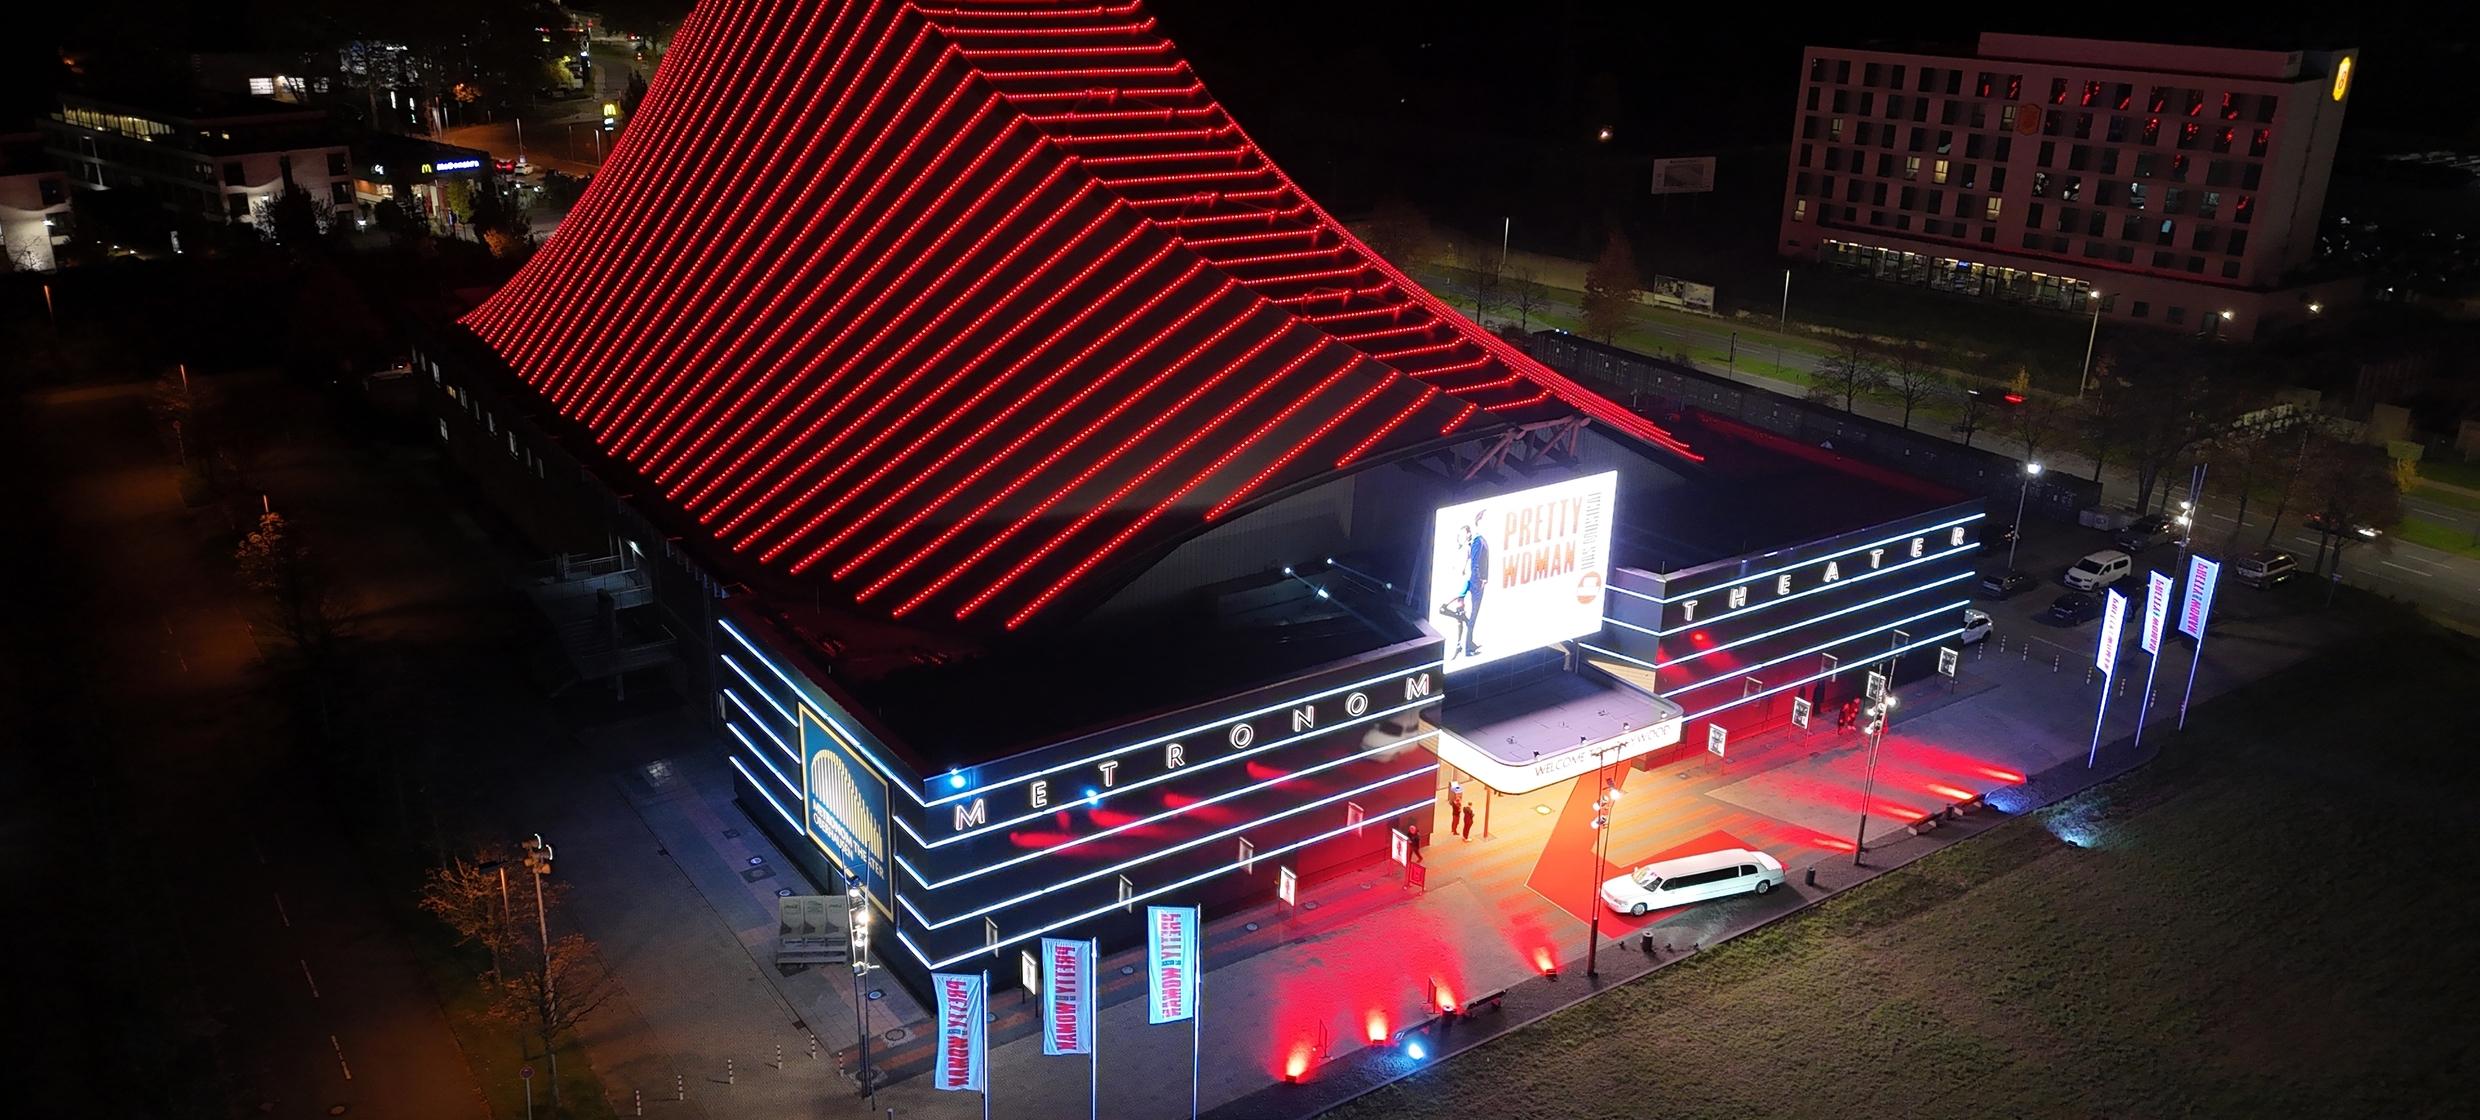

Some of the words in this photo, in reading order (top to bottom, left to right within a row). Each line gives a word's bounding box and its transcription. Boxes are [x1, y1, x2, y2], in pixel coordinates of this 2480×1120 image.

[1503, 496, 1582, 551] PRETTY
[1502, 541, 1576, 589] WOMAN
[1682, 526, 1965, 622] THEATER
[954, 672, 1430, 831] METRONOM
[813, 799, 853, 848] METRONOM
